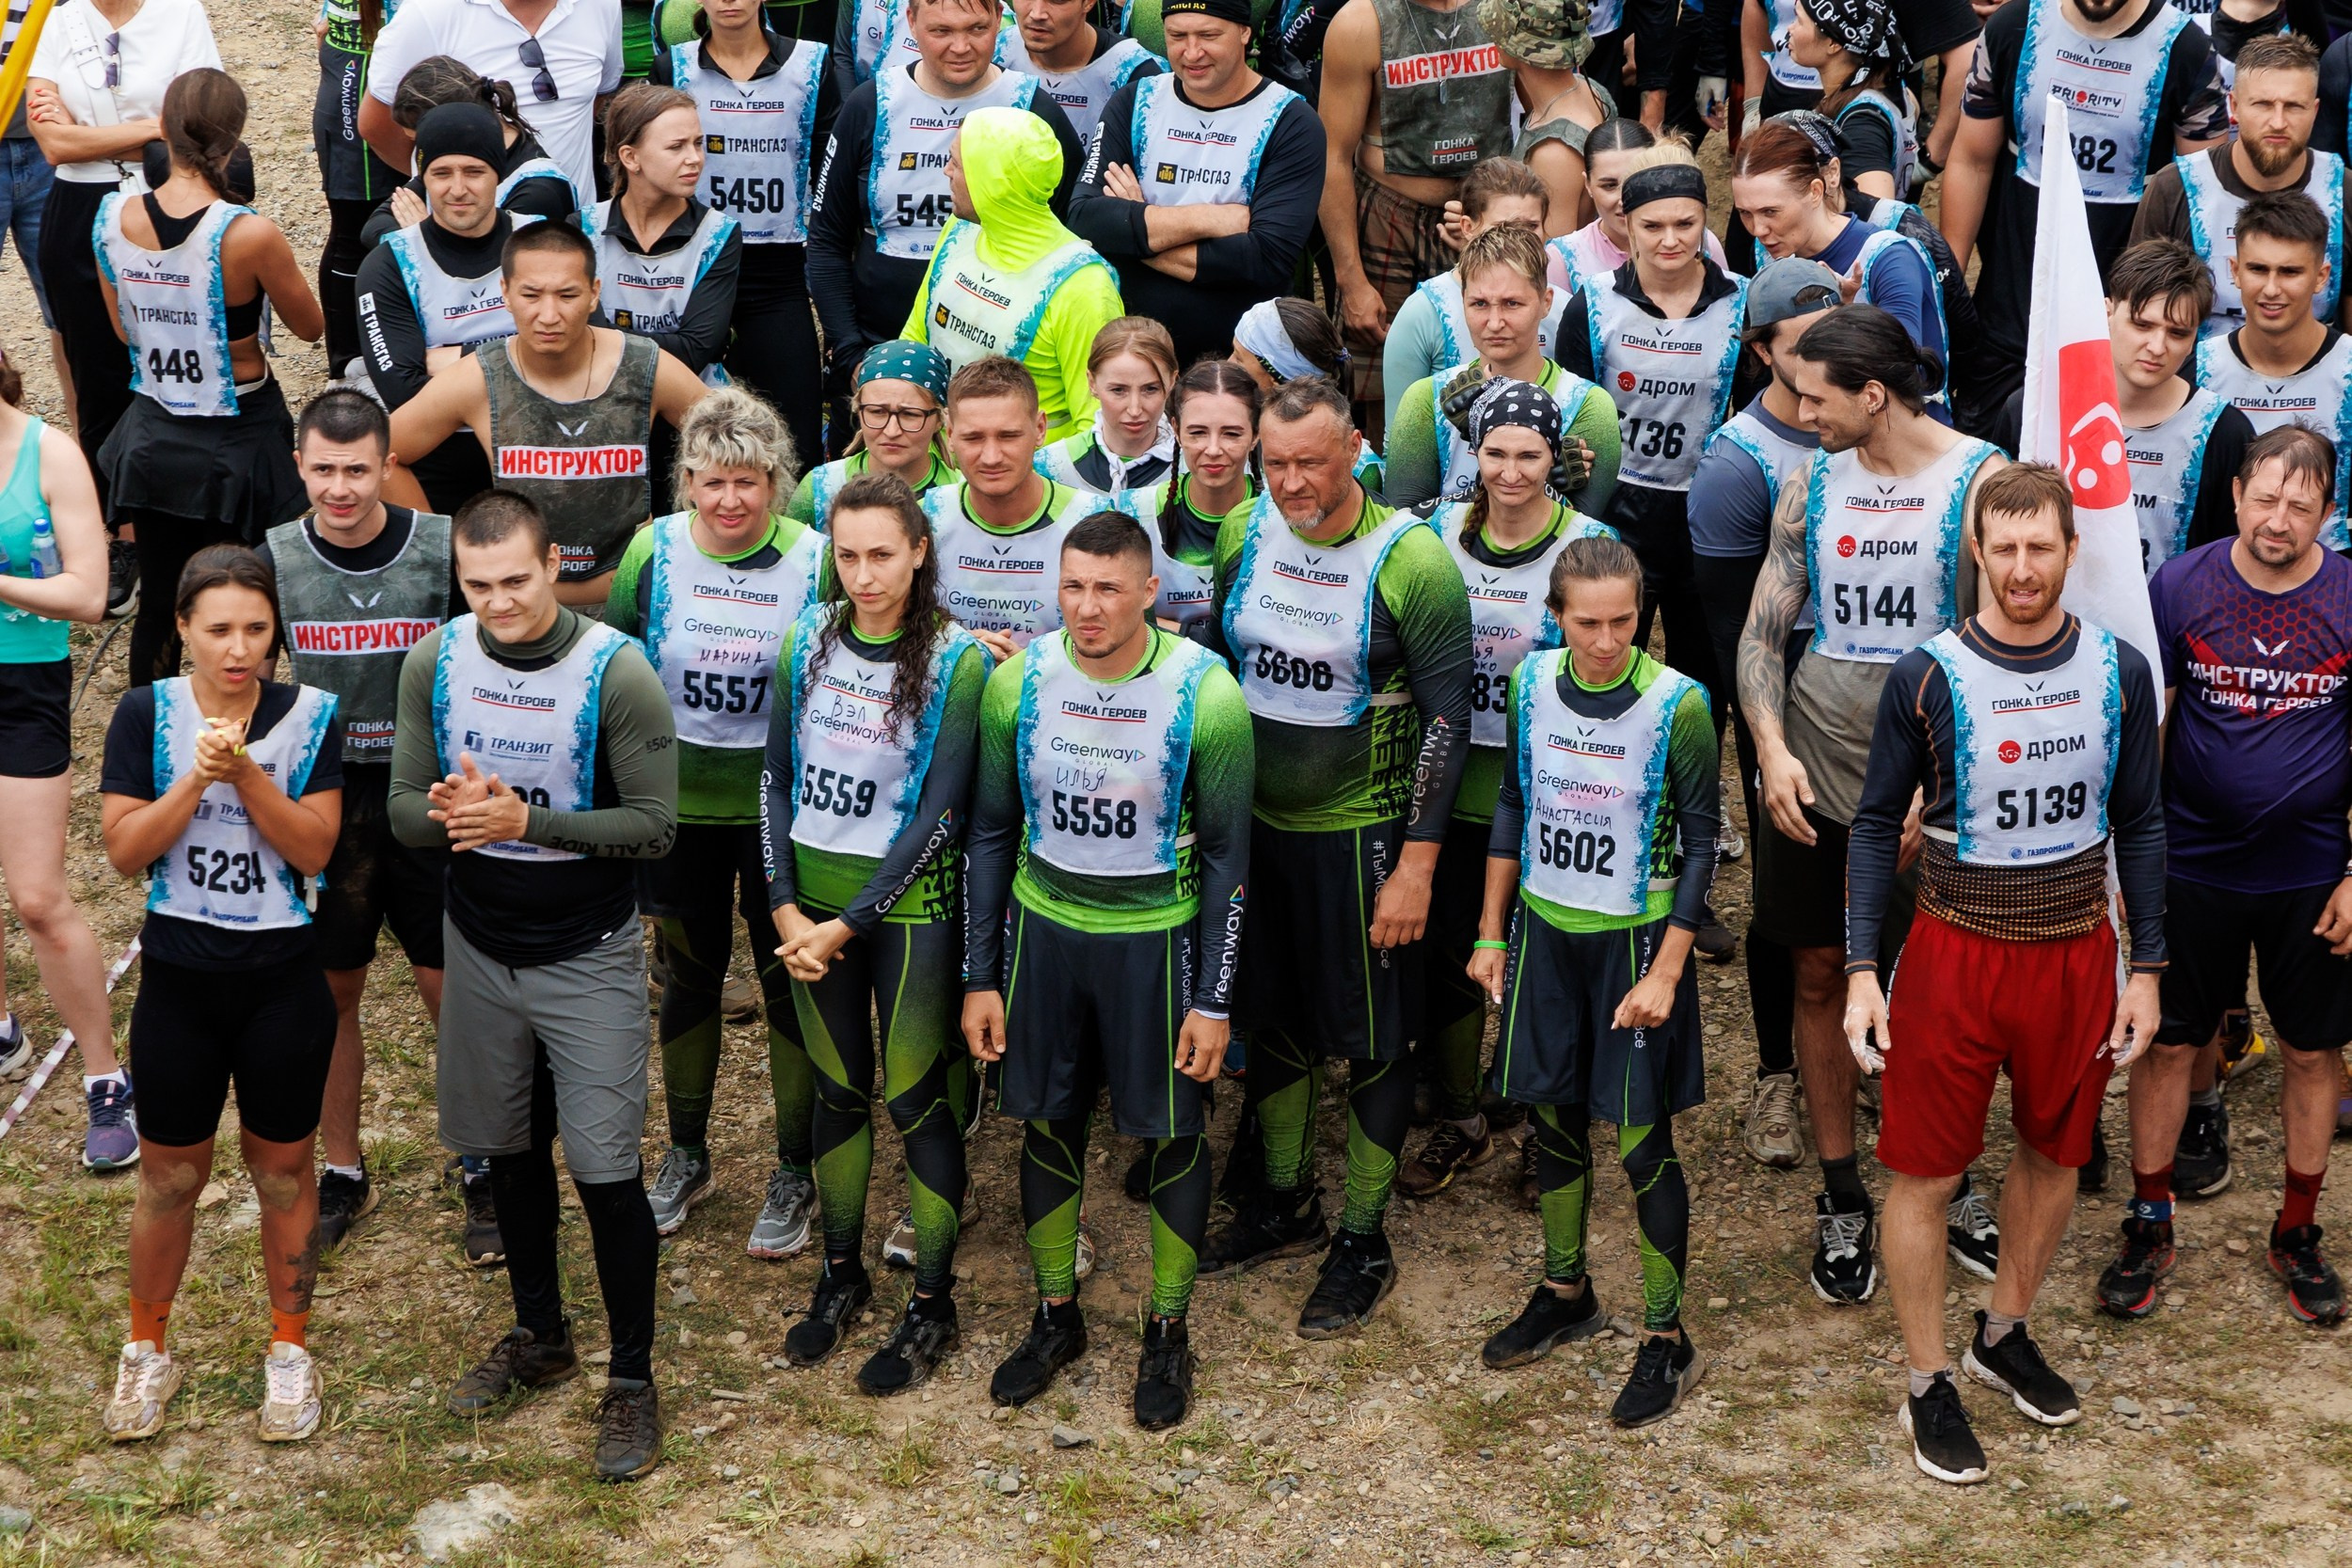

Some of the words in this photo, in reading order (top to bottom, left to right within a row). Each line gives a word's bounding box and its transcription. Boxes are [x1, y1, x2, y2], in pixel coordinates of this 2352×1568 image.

[1388, 48, 1500, 85] ИНСТРУКТО
[2057, 50, 2089, 65] ГОНКА
[2092, 58, 2132, 71] ГЕРОЕВ
[342, 70, 356, 140] Greenway
[710, 100, 743, 109] ГОНКА
[747, 101, 785, 109] ГЕРОЕВ
[910, 118, 943, 127] ГОНКА
[946, 119, 964, 127] ГЕР
[727, 137, 787, 152] ТРАНСГАЗ
[1435, 136, 1474, 149] ГОНКА
[921, 153, 950, 167] ТРАН
[1432, 150, 1478, 164] ГЕРОЕВ
[812, 155, 832, 213] ТРАНСГАЗ
[710, 176, 784, 214] 5450
[897, 194, 952, 228] 545
[121, 268, 151, 280] ГОНКА
[154, 272, 190, 283] ГЕРОЕВ
[617, 273, 649, 286] ГОНКА
[650, 276, 685, 286] ГЕРОЕВ
[956, 272, 977, 293] ГОНКА
[977, 286, 1011, 307] ГЕРОЕВ
[480, 295, 505, 309] ГЕРО
[139, 308, 198, 325] ТРАНСГАЗ
[949, 314, 996, 349] ТРАНСГАЗ
[365, 313, 393, 372] ТРАНСГАЗ
[1621, 334, 1658, 349] ГОНКА
[1661, 341, 1703, 352] ГЕРОЕВ
[148, 348, 203, 384] 448
[1639, 379, 1696, 399] дром
[2233, 397, 2269, 408] ГОНКА
[2272, 397, 2316, 408] ГЕРОЕВ
[1618, 410, 1687, 460] 136
[501, 449, 644, 476] ИНСТРУКТОР
[2126, 451, 2164, 462] ЕРОЕВ
[1846, 497, 1880, 509] ГОНКА
[1883, 498, 1925, 509] ГЕРОЕВ
[560, 546, 594, 555] ОНКА
[1860, 541, 1918, 561] дром
[959, 556, 995, 569] ГОНКА
[998, 561, 1044, 570] ГЕРОЕВ
[1273, 561, 1305, 578] ГОНКА
[1307, 569, 1349, 583] ГЕРОЕВ
[693, 585, 730, 597] ГОНКА
[734, 590, 778, 603] ГЕРОЕВ
[948, 591, 1034, 617] Greenway
[1168, 590, 1204, 601] ГОНКА
[1484, 588, 1528, 600] ГЕРОЕВ
[1260, 594, 1332, 625] Greenway
[1835, 583, 1917, 627] 5144
[685, 618, 767, 642] Greenway
[1859, 646, 1904, 657] ГАЗПРОМБАНК
[2187, 660, 2348, 694] ИНСТРУКТОР
[472, 687, 508, 703] ГОНКА
[511, 695, 555, 707] ГЕРОЕВ
[683, 670, 768, 714] 5557
[822, 674, 855, 692] ГОНКА
[859, 686, 901, 703] ГЕРОЕВ
[1472, 673, 1510, 714] 83
[1992, 697, 2031, 710] ГОНКА
[2036, 689, 2080, 706] ГЕРОЕВ
[1062, 701, 1099, 717] ГОНКА
[1102, 707, 1147, 720] ГЕРОЕВ
[348, 721, 395, 734] ГОНКА
[810, 709, 882, 743] Greenway
[490, 736, 554, 754] ТРАНЗИТ
[1051, 736, 1135, 763] Greenway
[1548, 734, 1579, 750] ГОНКА
[1581, 741, 1626, 755] ГЕРОЕВ
[2026, 734, 2086, 761] дром
[802, 764, 877, 817] 5559
[1536, 769, 1613, 799] Greenway
[219, 803, 248, 817] ТРАН
[1052, 789, 1136, 839] 5558
[1996, 781, 2088, 831] 5139
[759, 769, 775, 868] Greenway
[490, 842, 538, 853] ГАЗПРОМБАНК
[1539, 822, 1616, 877] 5602
[2027, 842, 2075, 857] ГАЗПРОМБАНК
[188, 846, 266, 895] 5234
[875, 822, 949, 913] Greenway
[1213, 902, 1244, 1004] reenway
